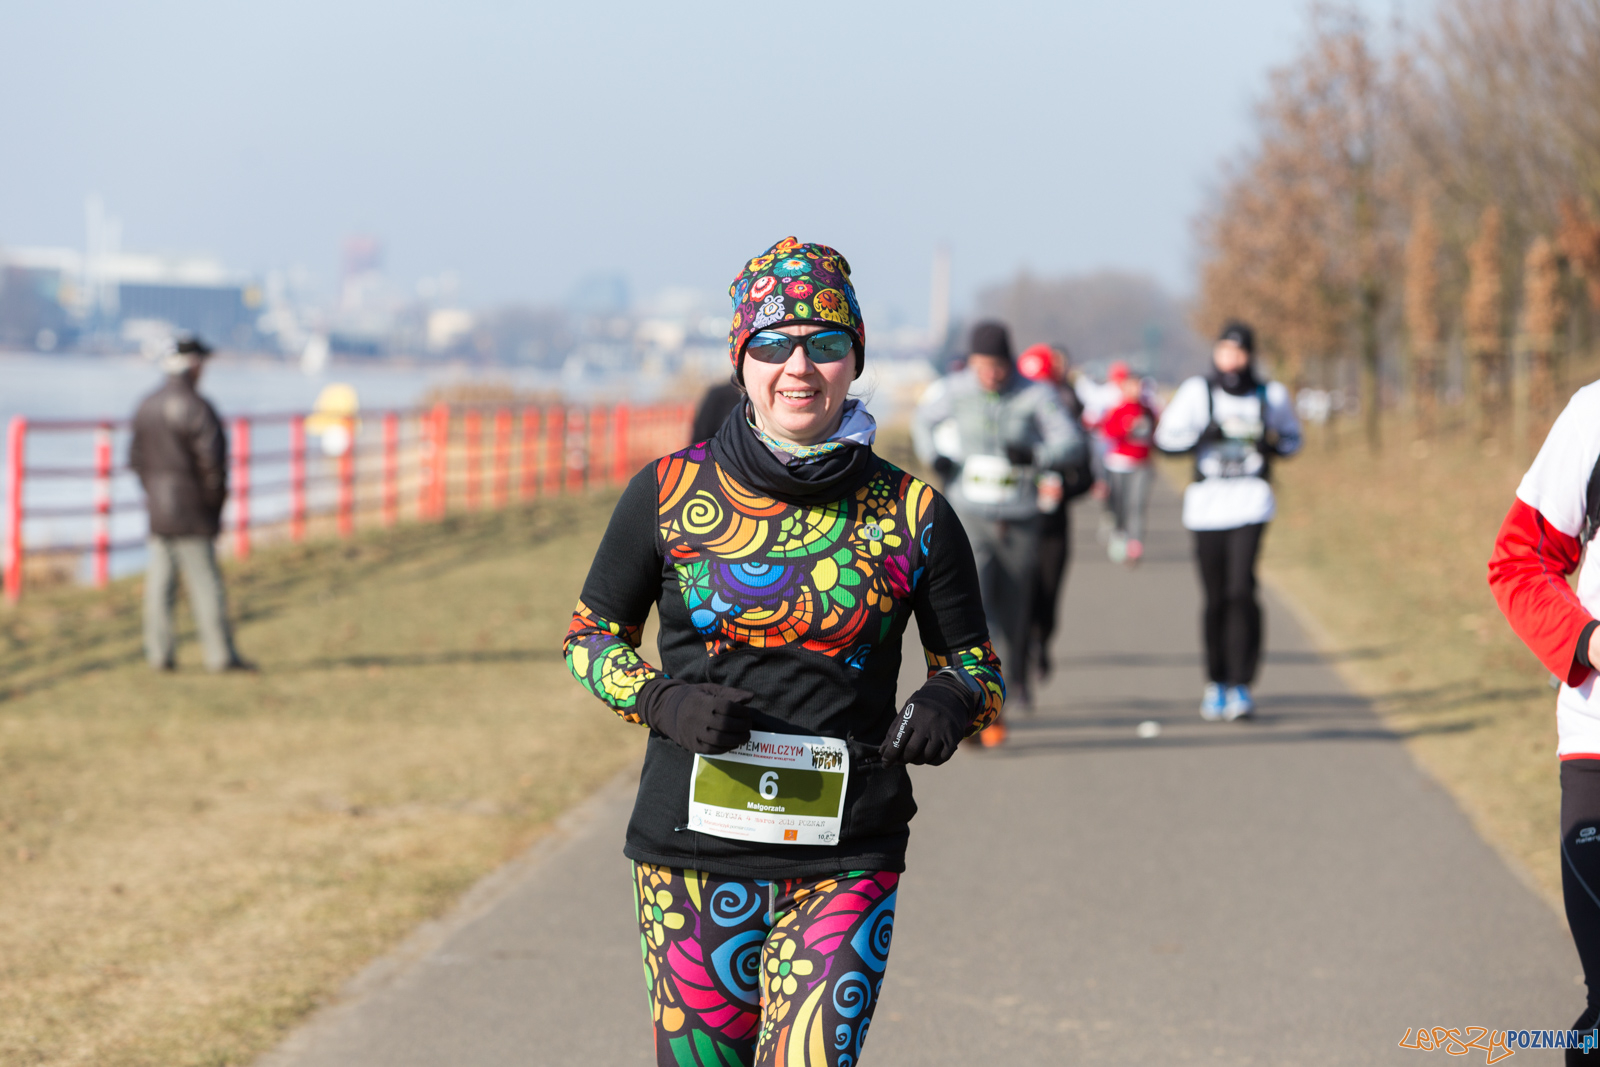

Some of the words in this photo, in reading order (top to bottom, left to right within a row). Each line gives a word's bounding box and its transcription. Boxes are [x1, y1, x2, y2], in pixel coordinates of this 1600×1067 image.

[892, 720, 908, 748] Kalenji
[759, 771, 778, 800] 6
[778, 818, 795, 826] 2018
